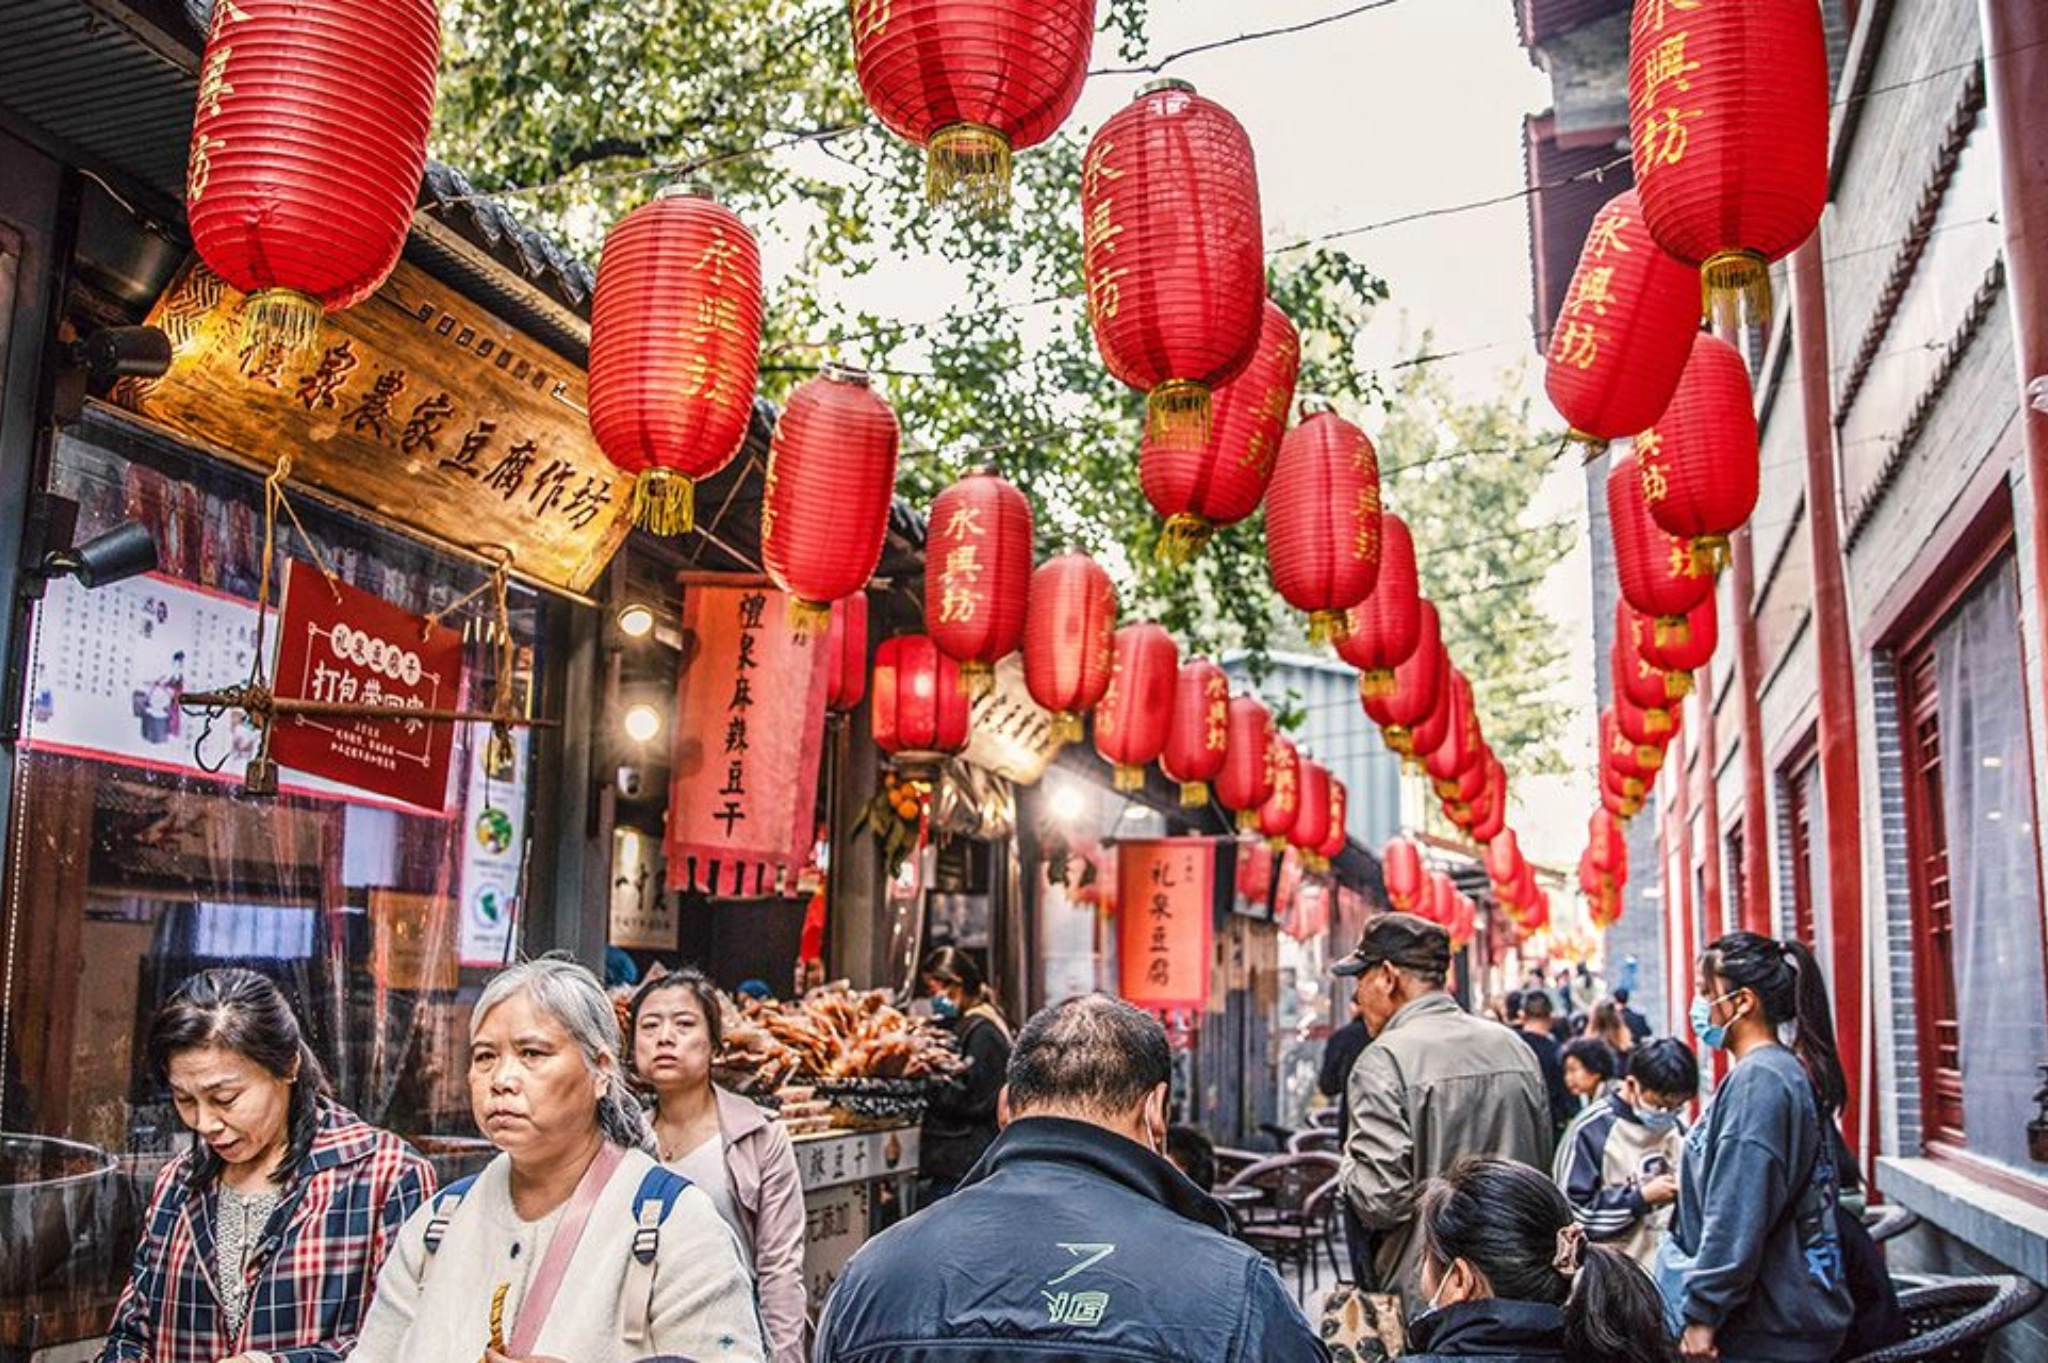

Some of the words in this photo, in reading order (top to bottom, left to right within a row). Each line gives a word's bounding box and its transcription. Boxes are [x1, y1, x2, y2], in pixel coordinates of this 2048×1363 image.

[1556, 206, 1631, 370] 永興坊
[939, 503, 985, 623] 永興坊
